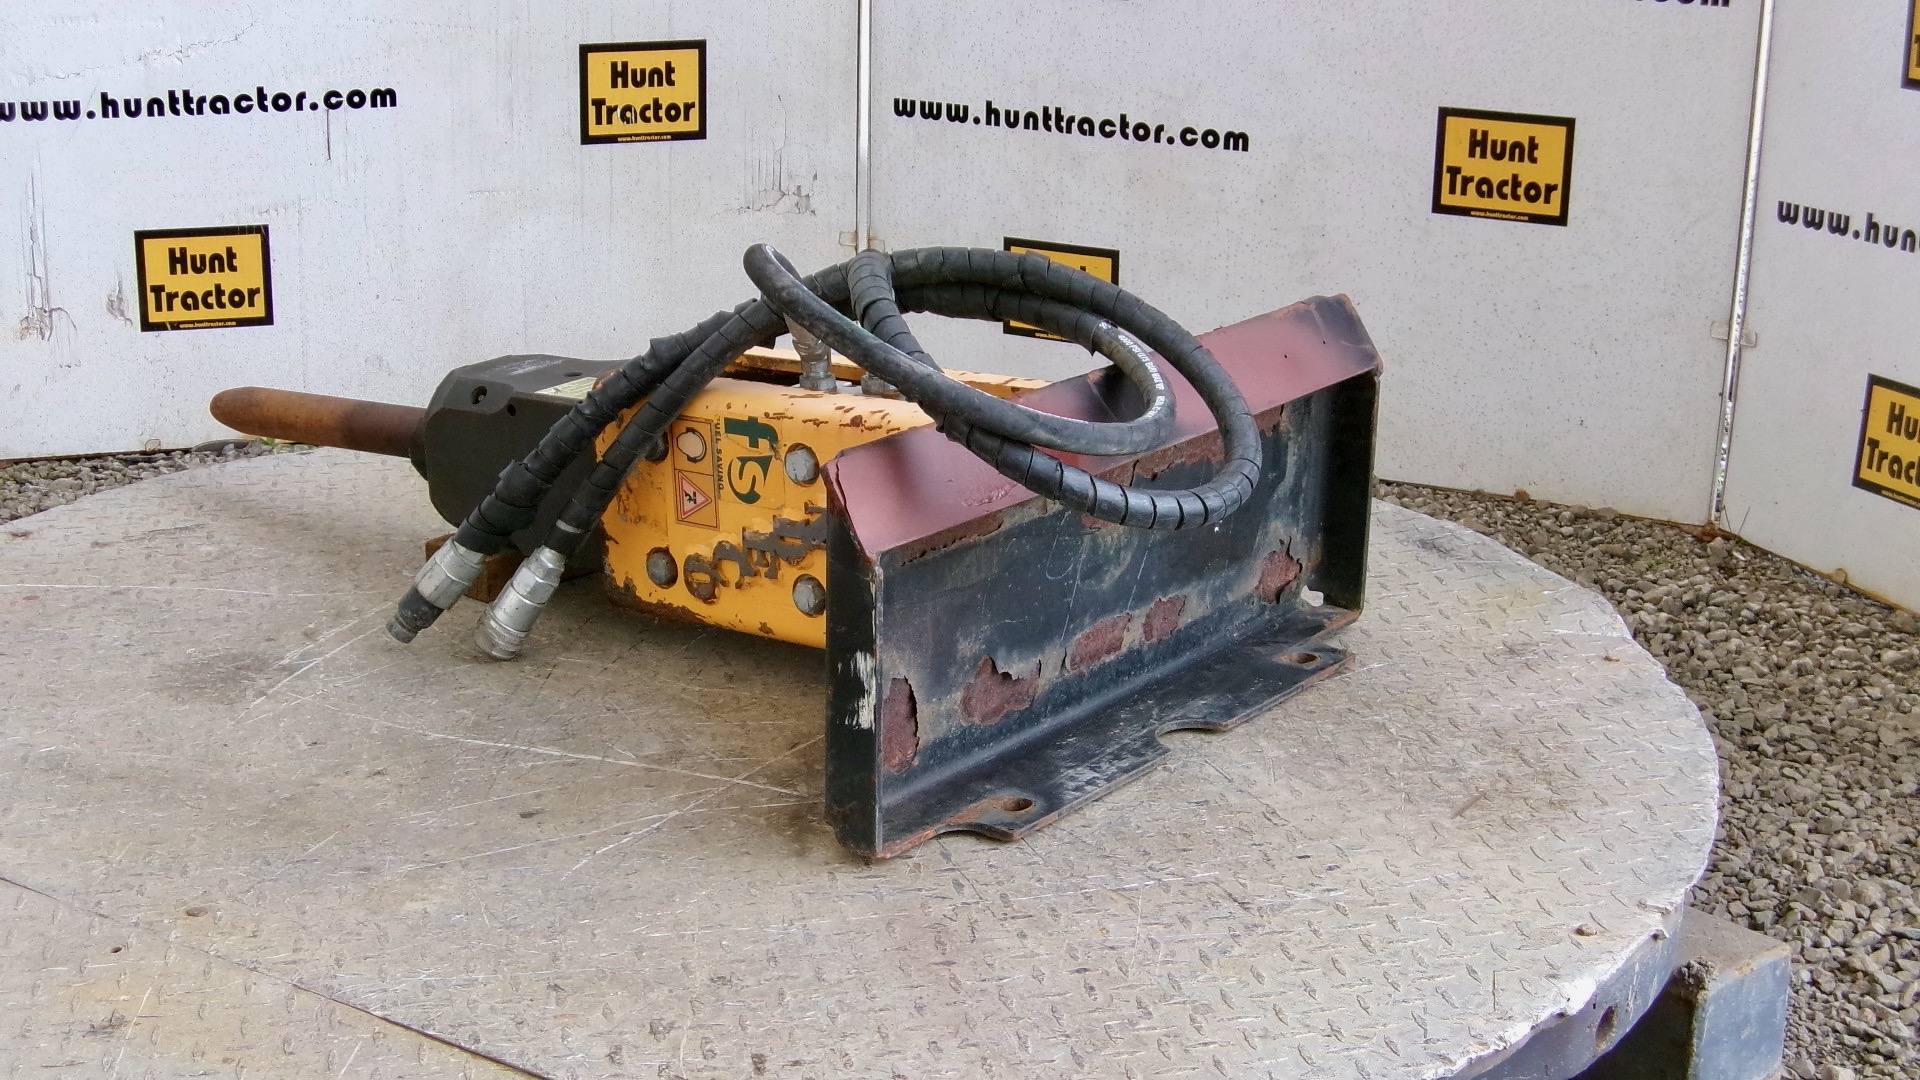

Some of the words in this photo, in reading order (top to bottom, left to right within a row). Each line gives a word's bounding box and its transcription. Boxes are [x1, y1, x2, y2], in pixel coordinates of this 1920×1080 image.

[611, 61, 675, 88] Hunt
[591, 97, 695, 125] Tractor
[894, 97, 1249, 152] www.hunttractor.com
[1468, 128, 1539, 164] Hunt
[1446, 165, 1558, 204] Tractor
[1777, 200, 1920, 253] www.hun
[168, 246, 237, 275] Hunt
[150, 283, 260, 312] Tractor
[1886, 401, 1920, 443] Hu
